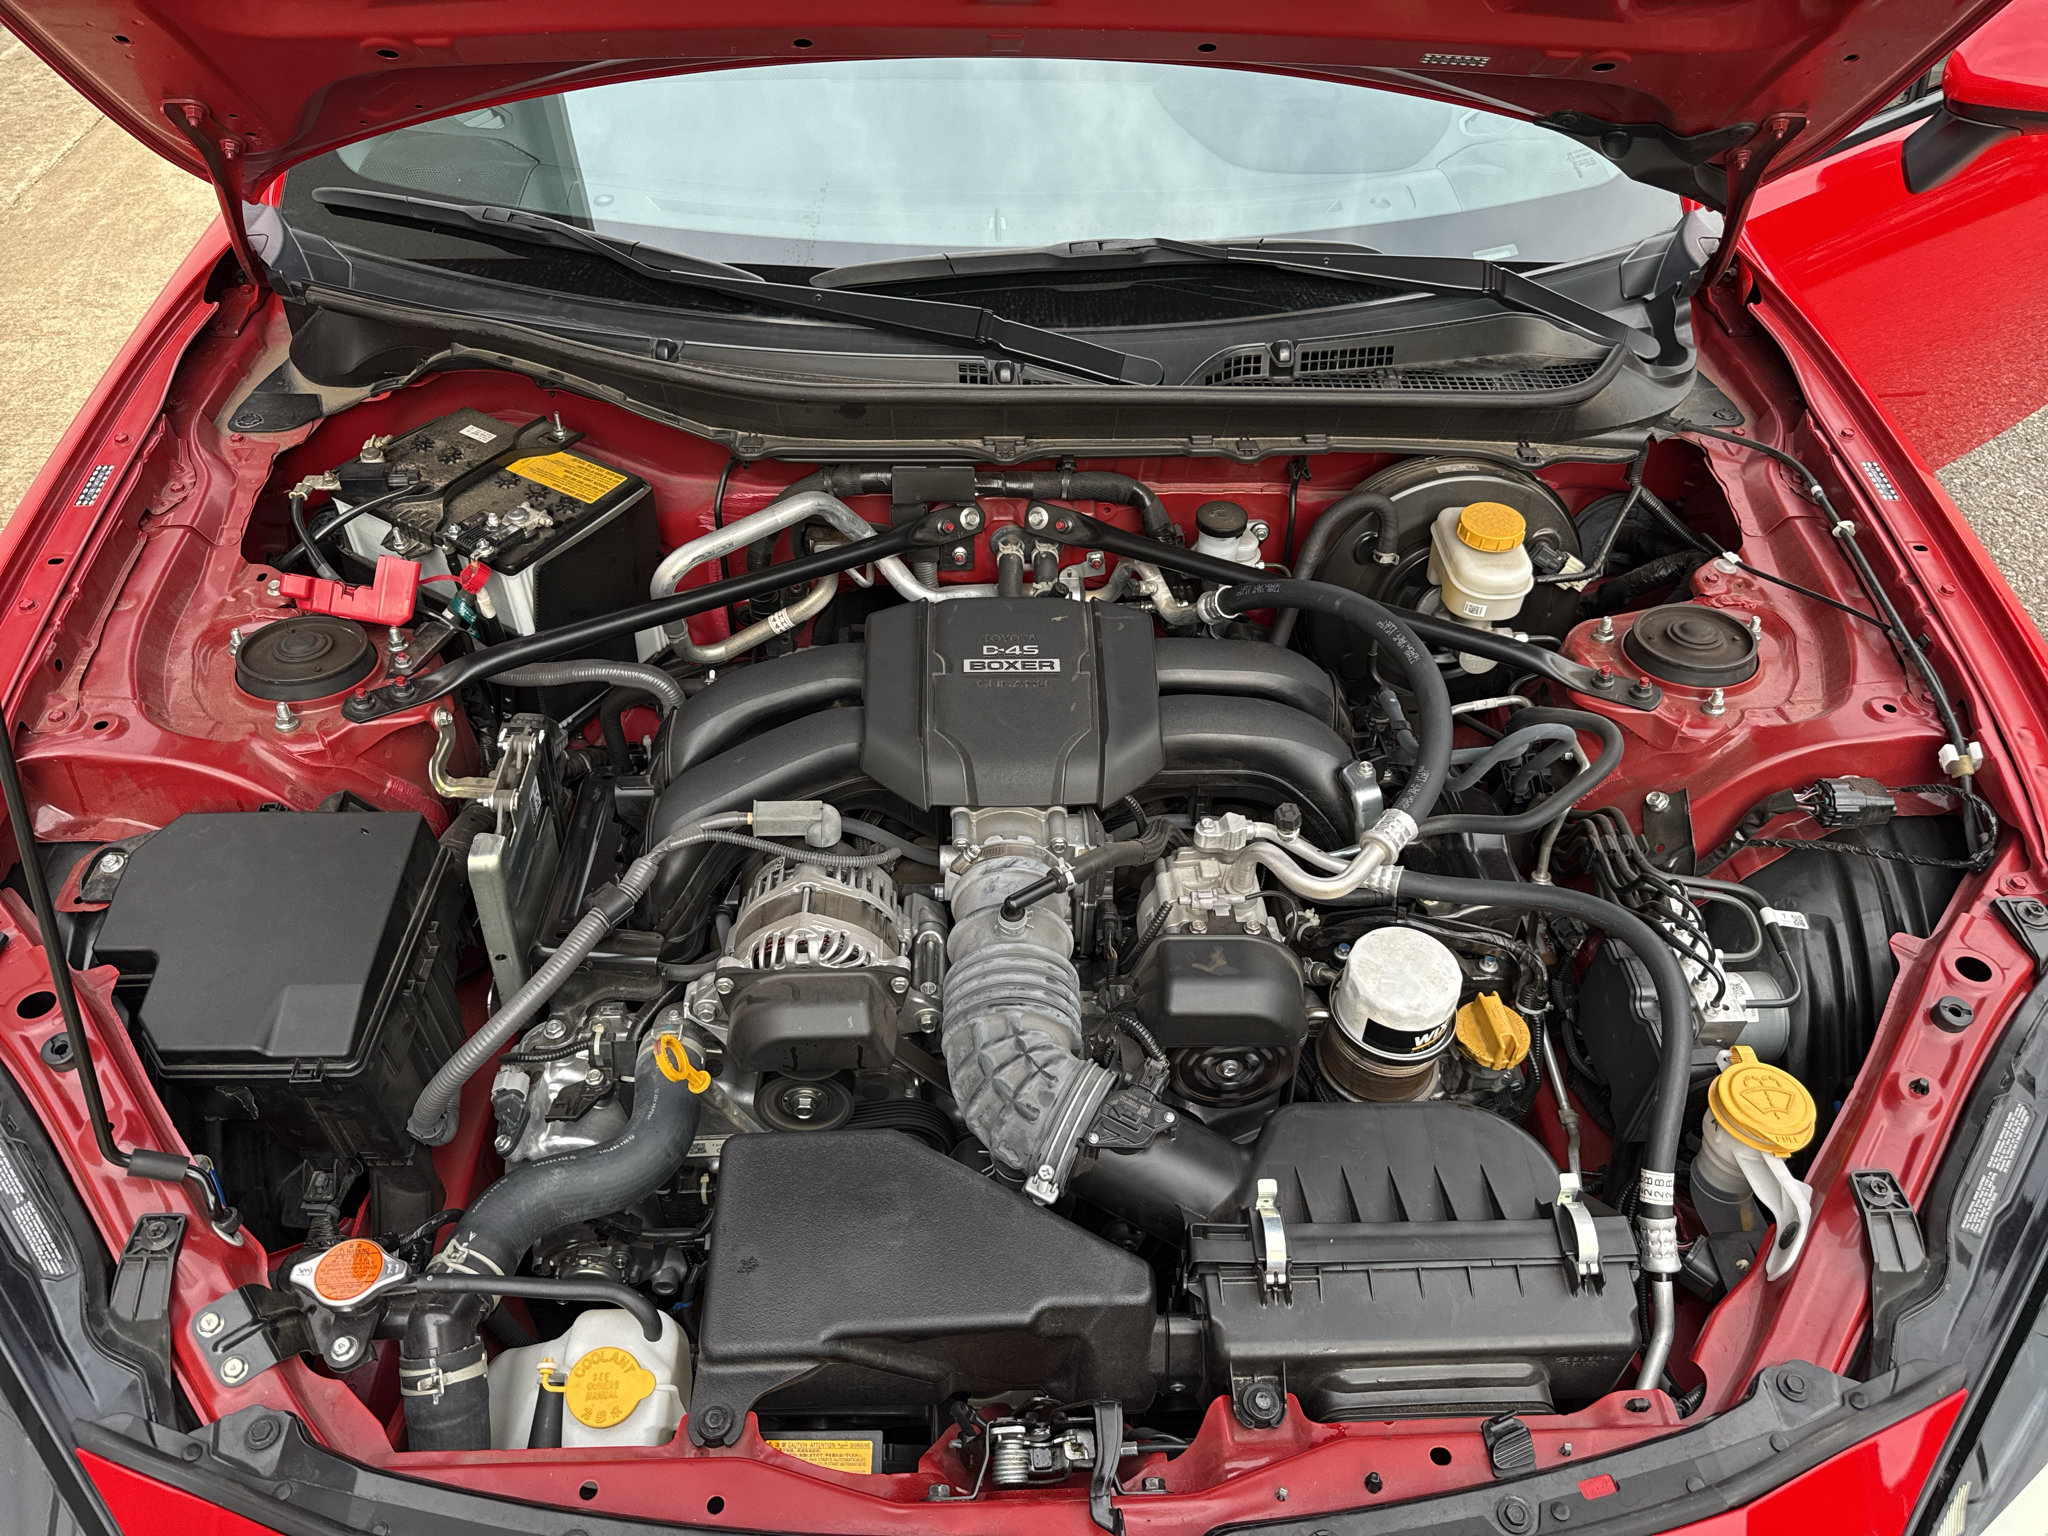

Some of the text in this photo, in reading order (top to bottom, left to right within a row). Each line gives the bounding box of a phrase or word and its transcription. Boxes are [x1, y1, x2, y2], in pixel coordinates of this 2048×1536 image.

[983, 634, 1039, 642] TOYOTA
[983, 645, 1039, 655] D-4S
[969, 661, 1055, 670] BOXER
[574, 1351, 636, 1378] COOLANT
[593, 1372, 610, 1381] SEE
[585, 1391, 618, 1400] MANUAL
